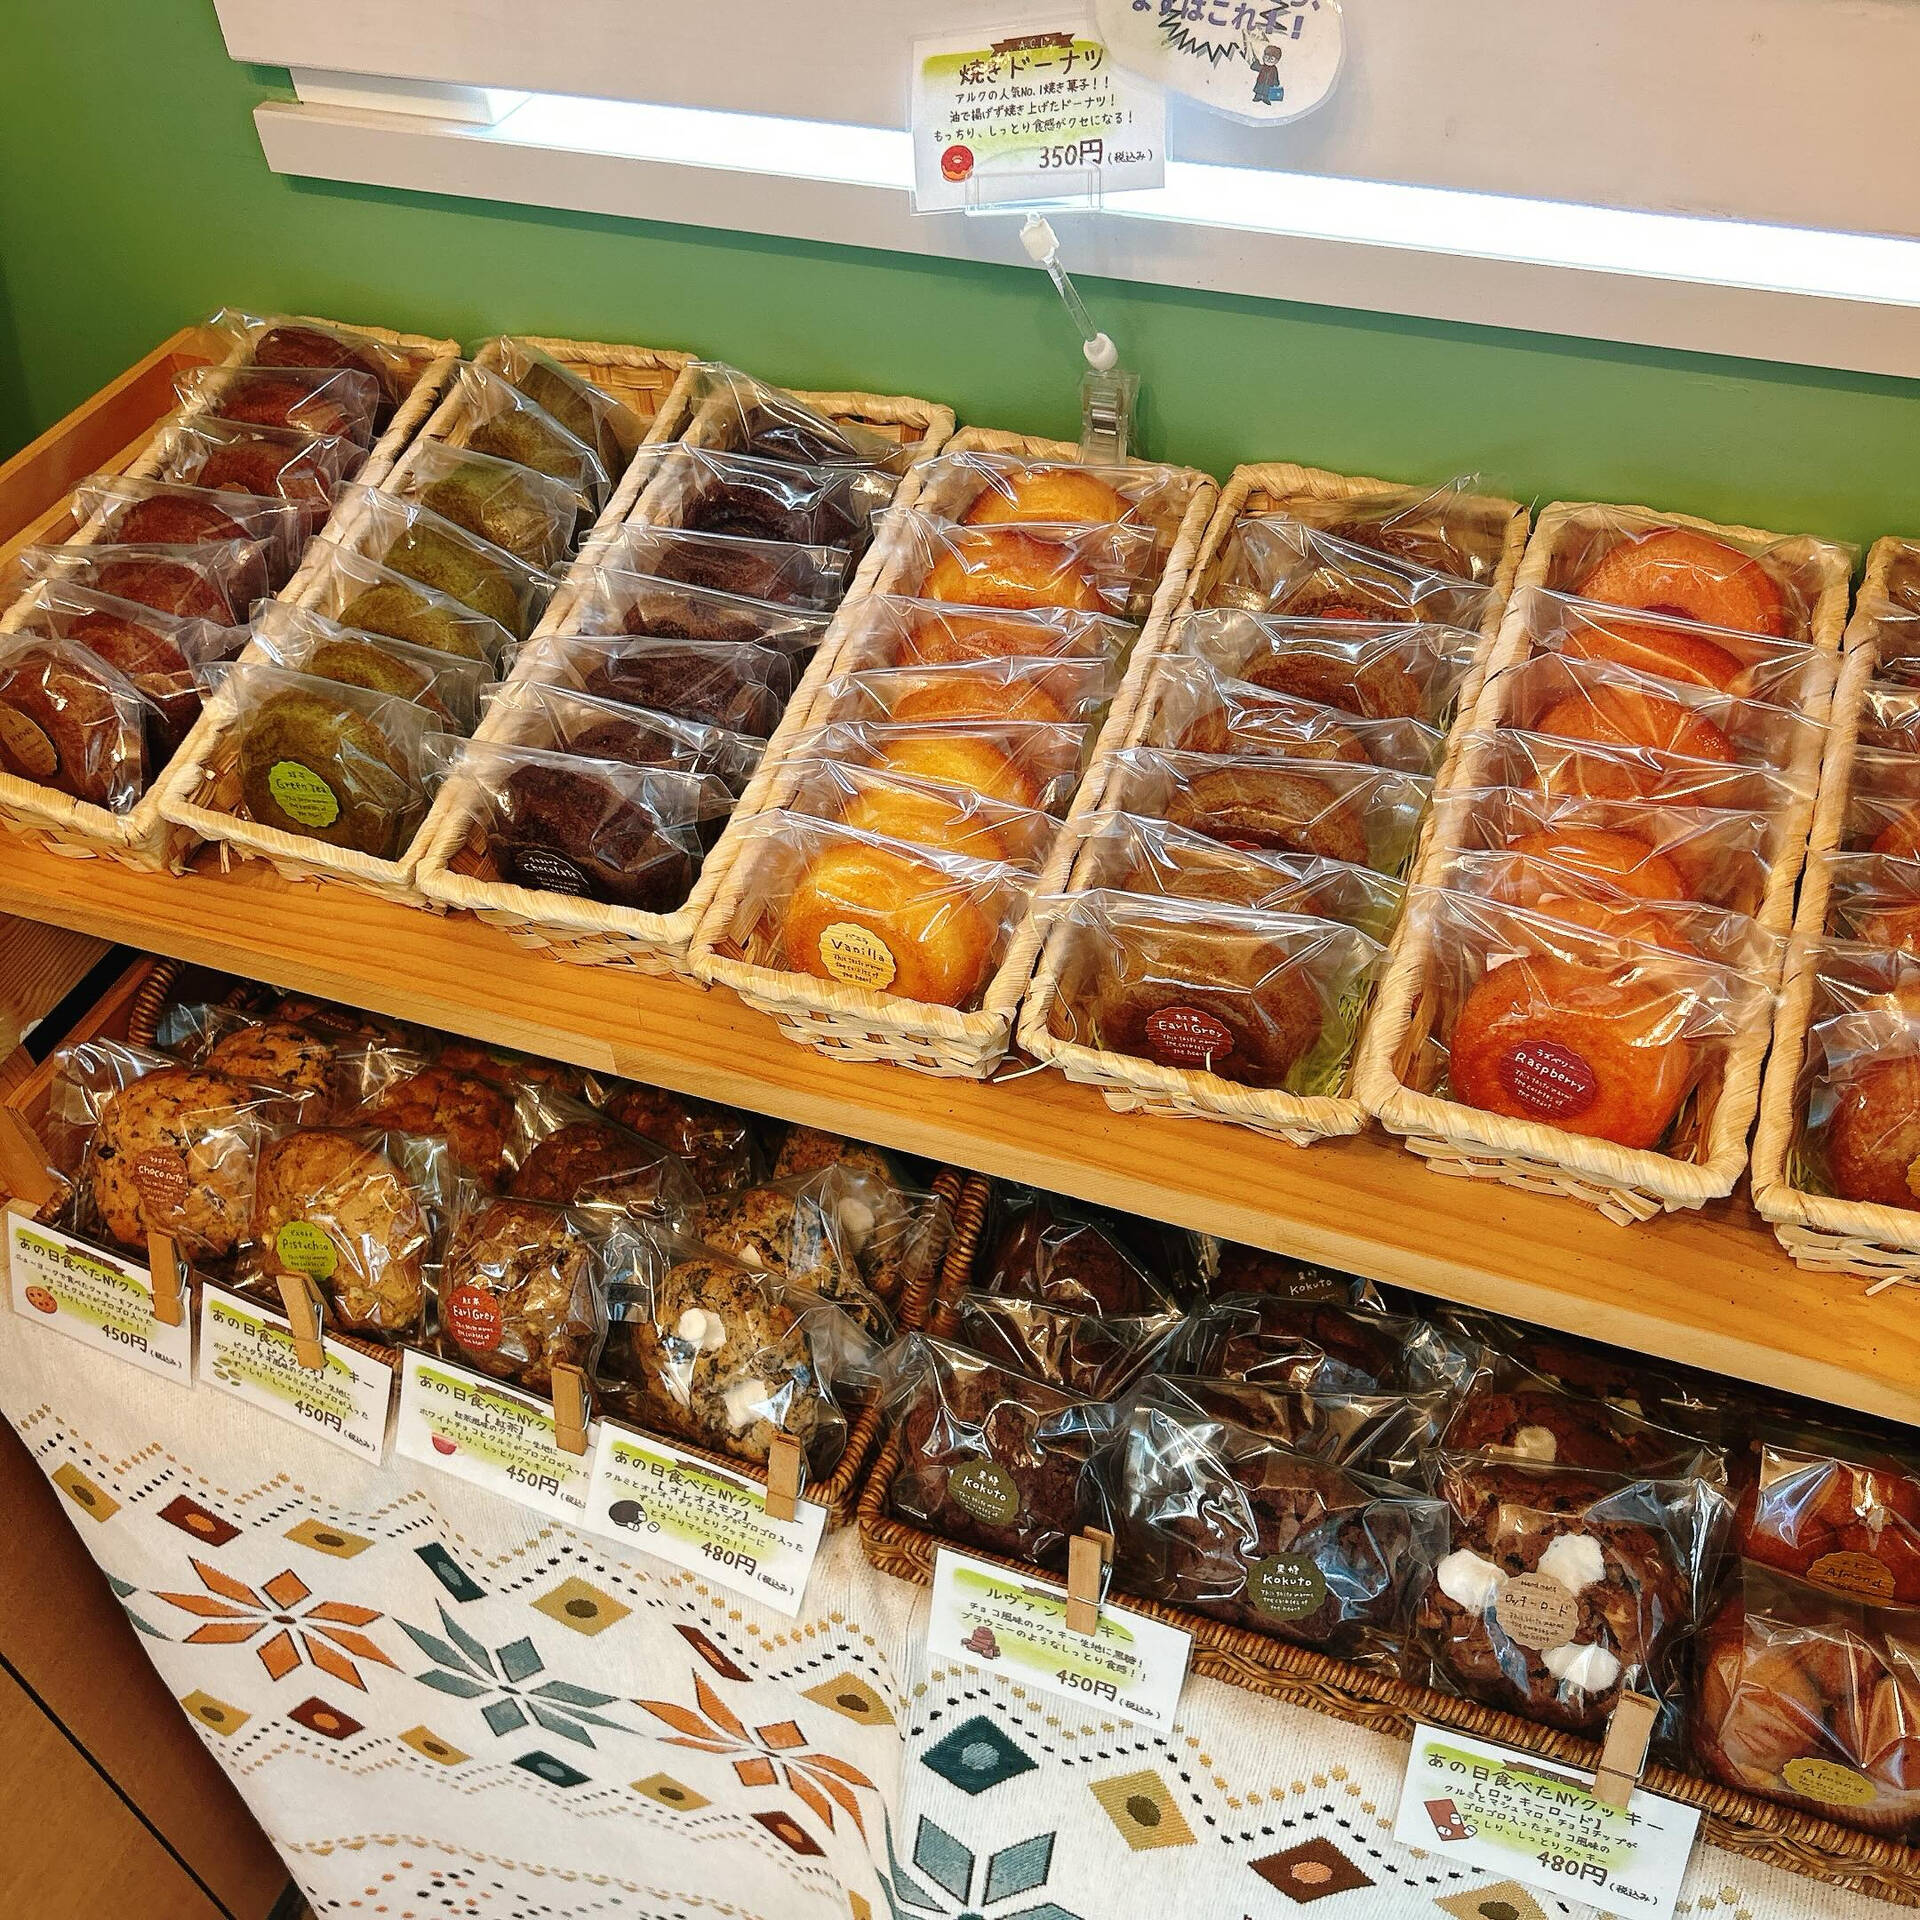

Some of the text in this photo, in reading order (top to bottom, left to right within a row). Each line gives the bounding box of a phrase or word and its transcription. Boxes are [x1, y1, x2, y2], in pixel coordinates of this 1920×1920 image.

[959, 48, 1103, 86] 焼きドーナツ
[949, 94, 1115, 123] 油で揚げず焼き上げたドーナツ！
[934, 112, 1133, 143] もっちり、しっとり食感がクセになる！
[1039, 138, 1103, 168] 350円
[276, 778, 307, 791] Green
[523, 863, 579, 880] Chocolate
[831, 938, 885, 963] Vanilla
[1158, 1020, 1223, 1038] Earl Grey
[1515, 1052, 1586, 1093] Raspberry
[1537, 1049, 1575, 1070] ラズベリー
[282, 1238, 328, 1251] Pistachio
[1289, 1279, 1332, 1296] Kokuto
[453, 1305, 495, 1322] Earl Grey
[101, 1324, 148, 1354] 450円
[295, 1399, 342, 1433] 450円
[506, 1464, 586, 1509] 450円 （税込
[658, 1481, 750, 1522] 【オレオスモア】
[962, 1475, 1007, 1502] Kokuto
[701, 1541, 757, 1577] 480円
[1262, 1573, 1312, 1587] Kokuto
[1824, 1567, 1883, 1589] Almond
[986, 1585, 1135, 1643] ルヴァンキー
[1505, 1594, 1572, 1618] ロッキーロード
[961, 1610, 1147, 1683] ブラウニーのようなしっとり食感！！
[969, 1601, 1144, 1668] チョコ風味のクッキー生地に黒糖！
[1055, 1669, 1118, 1703] 450円
[1428, 1752, 1665, 1833] あの日食べたNYクッキー
[1473, 1781, 1603, 1831] 【ロッキーロード】
[1444, 1784, 1639, 1850] クルミとマシュマロ、チョコチップが
[1463, 1802, 1611, 1854] ゴロゴロ入ったチョコ風味の
[1461, 1812, 1608, 1865] ずっしり、しっとりクッキー
[1537, 1851, 1609, 1888] 480円
